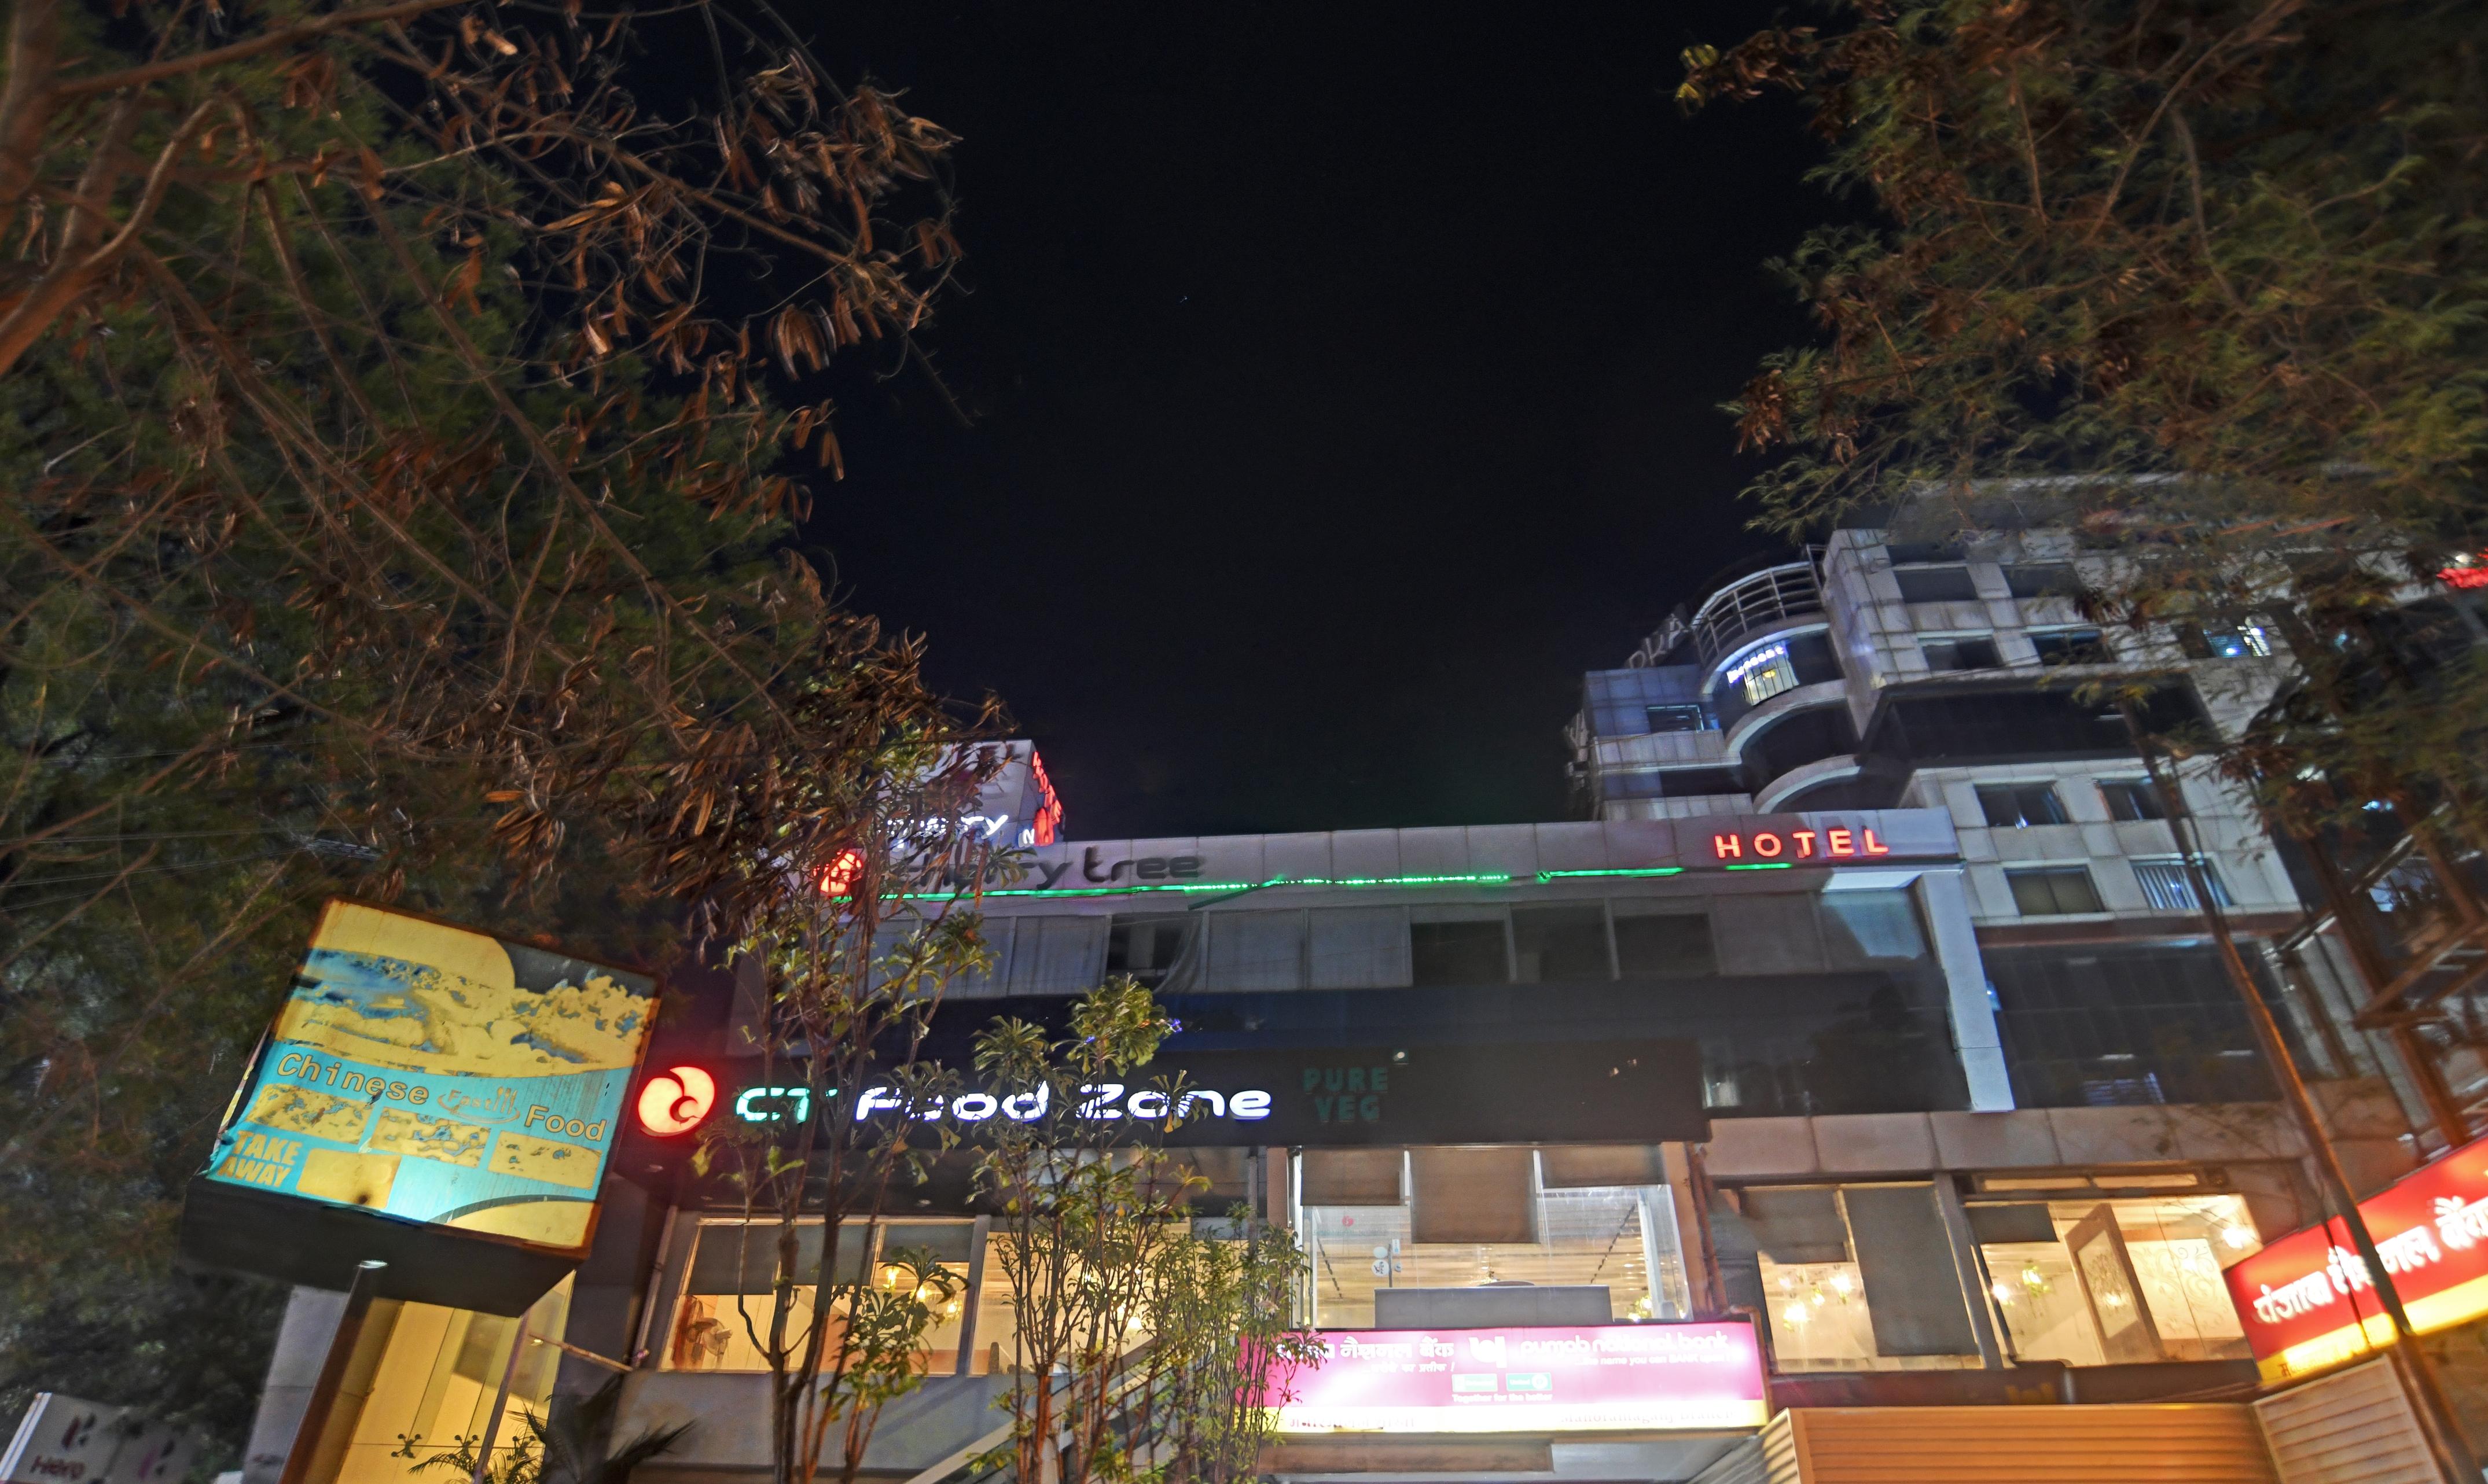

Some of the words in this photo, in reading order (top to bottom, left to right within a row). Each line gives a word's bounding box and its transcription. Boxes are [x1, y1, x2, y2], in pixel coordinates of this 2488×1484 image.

[1714, 828, 1889, 858] HOTEL
[1083, 846, 1201, 883] tree
[1303, 1066, 1388, 1092] PURE
[277, 1052, 429, 1104] Chinese
[448, 1089, 492, 1111] Fast
[524, 1104, 607, 1141] Food
[1076, 1082, 1271, 1120] Zone
[1314, 1095, 1380, 1121] VEG
[234, 1130, 304, 1165] TAKE
[216, 1157, 292, 1187] AWAY
[2253, 1271, 2335, 1324] पंजाब
[1600, 1357, 1628, 1366] name
[1629, 1357, 1648, 1367] you
[1451, 1394, 1493, 1404] Together
